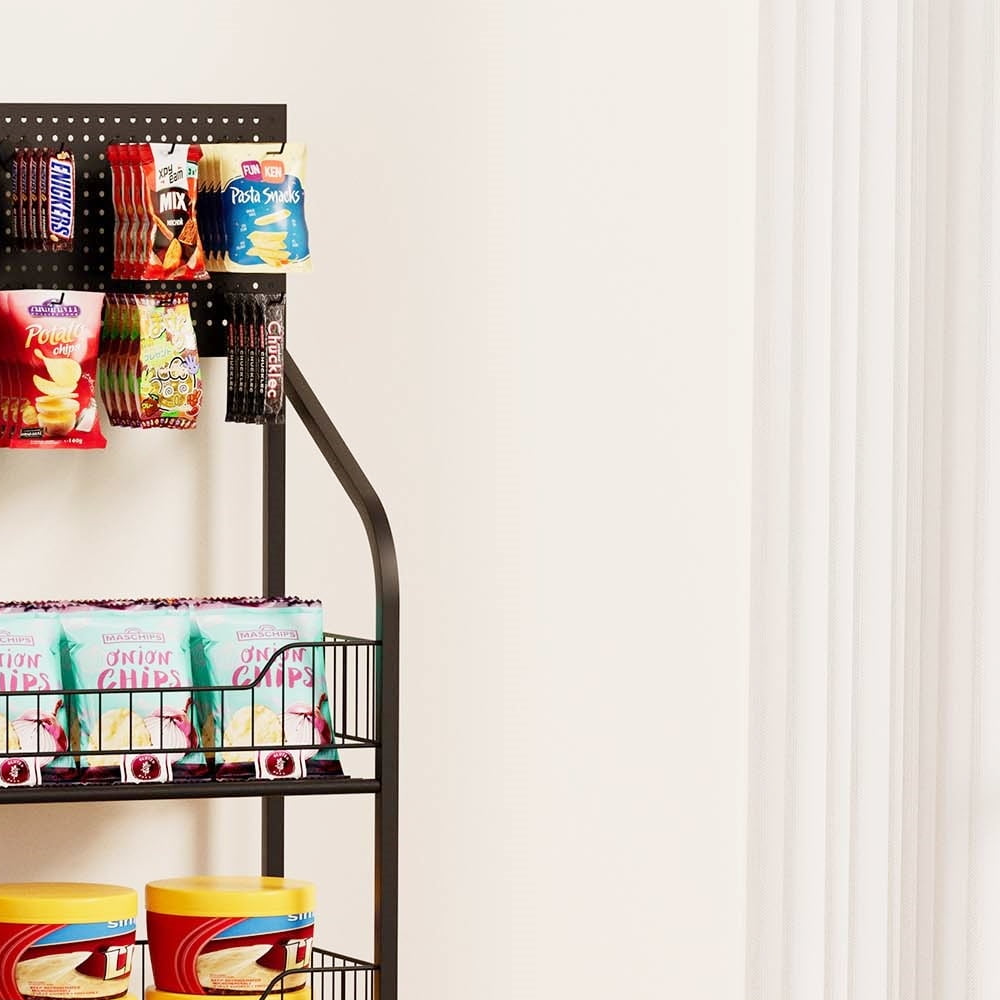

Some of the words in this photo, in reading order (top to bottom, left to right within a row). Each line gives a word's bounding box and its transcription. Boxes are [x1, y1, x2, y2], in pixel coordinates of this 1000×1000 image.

[243, 164, 260, 176] FUN
[264, 166, 282, 178] KEN
[160, 192, 187, 213] MIX
[230, 186, 260, 204] Pasta
[263, 186, 300, 204] Snacks
[25, 322, 87, 348] Potato
[53, 344, 80, 358] chips
